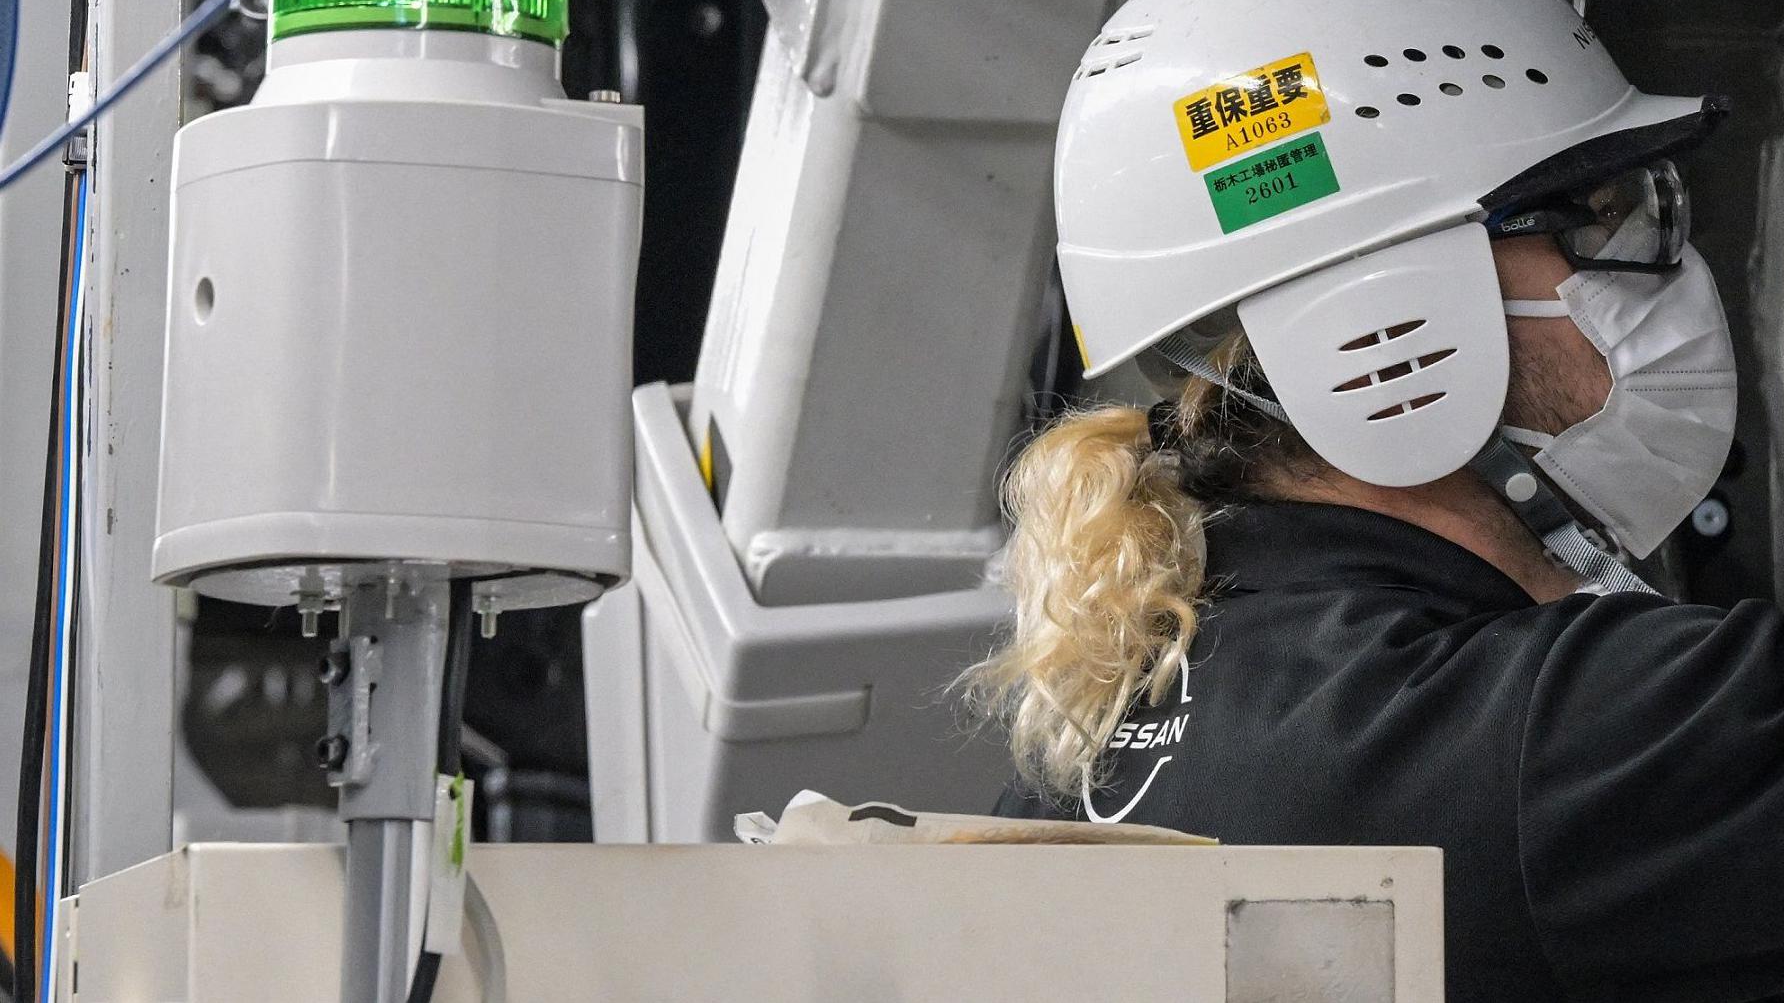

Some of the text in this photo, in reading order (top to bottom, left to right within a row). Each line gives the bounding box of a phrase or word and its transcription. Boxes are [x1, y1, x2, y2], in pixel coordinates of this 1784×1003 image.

[1186, 63, 1308, 140] 重保重要
[1226, 111, 1292, 151] A1063
[1245, 171, 1299, 205] 2601
[1109, 713, 1190, 749] SSAN
